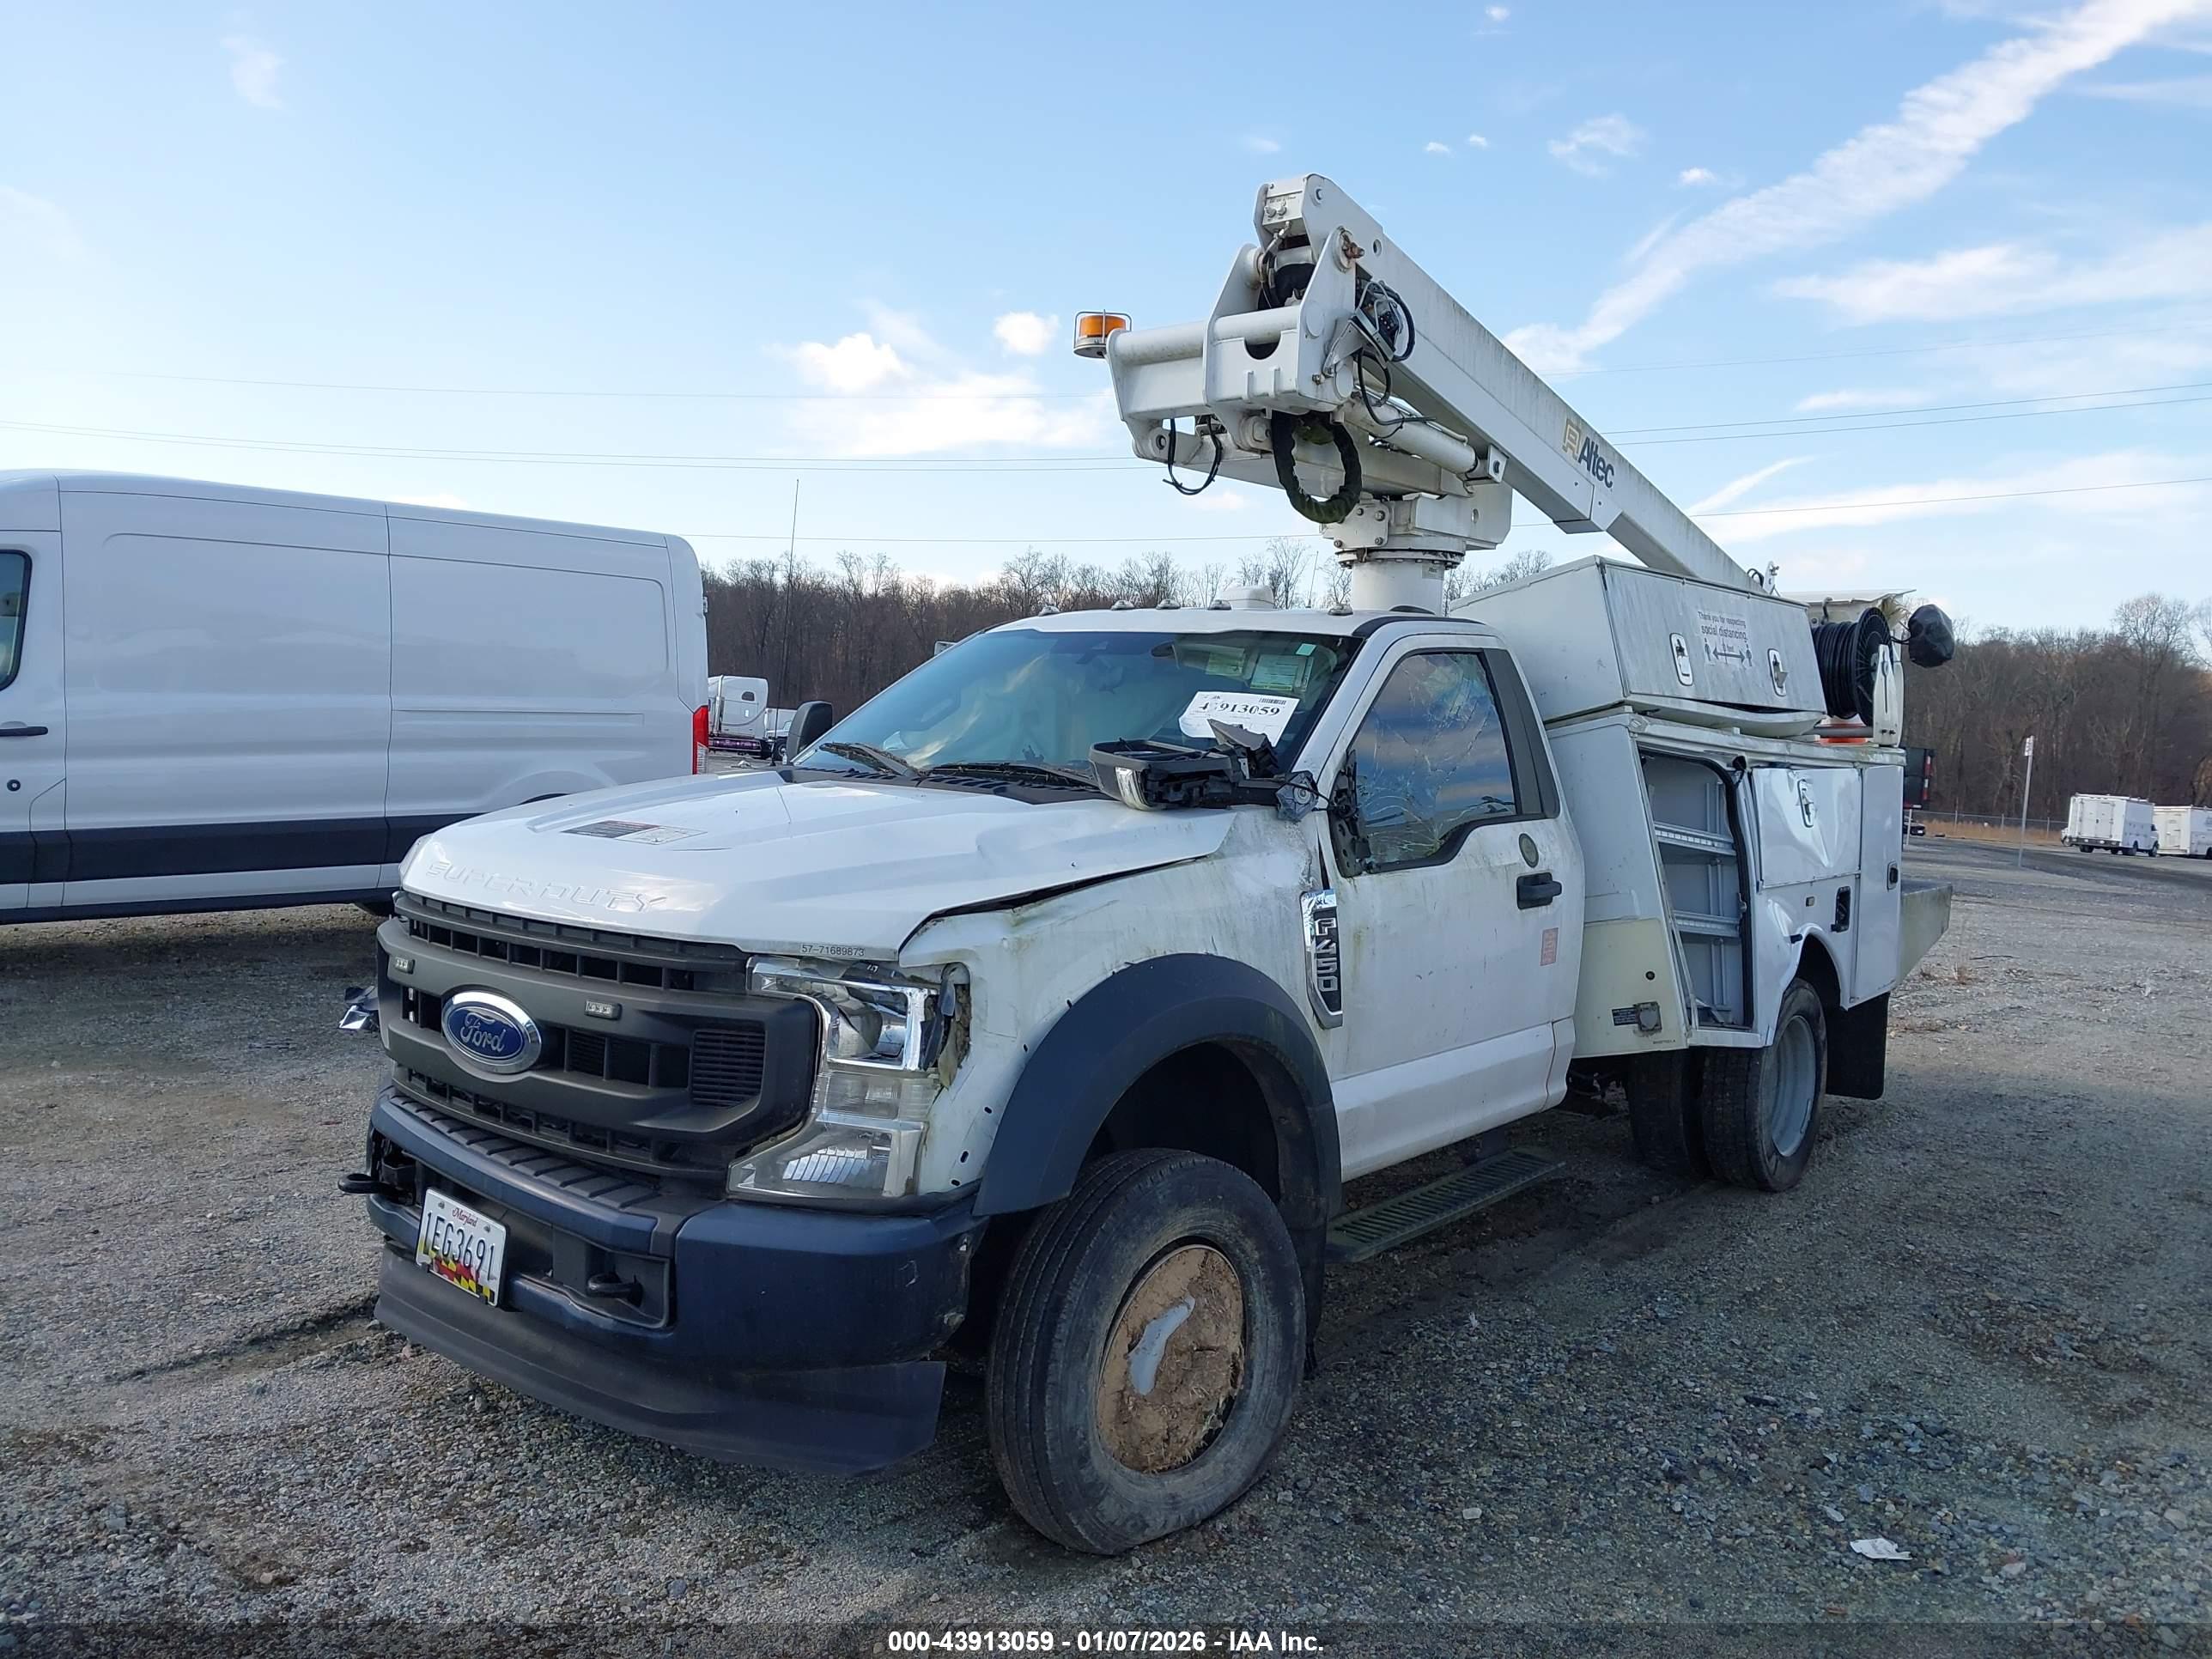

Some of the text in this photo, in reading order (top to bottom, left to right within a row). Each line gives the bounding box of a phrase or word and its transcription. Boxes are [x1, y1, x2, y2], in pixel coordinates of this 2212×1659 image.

[1578, 436, 1614, 488] Altec
[1701, 624, 1718, 635] social
[427, 860, 667, 913] SUPER DUTY
[802, 944, 865, 957] 57-71689873
[459, 1012, 507, 1052] Ford
[453, 1206, 478, 1227] Maryland
[422, 1211, 495, 1281] 1EG3691
